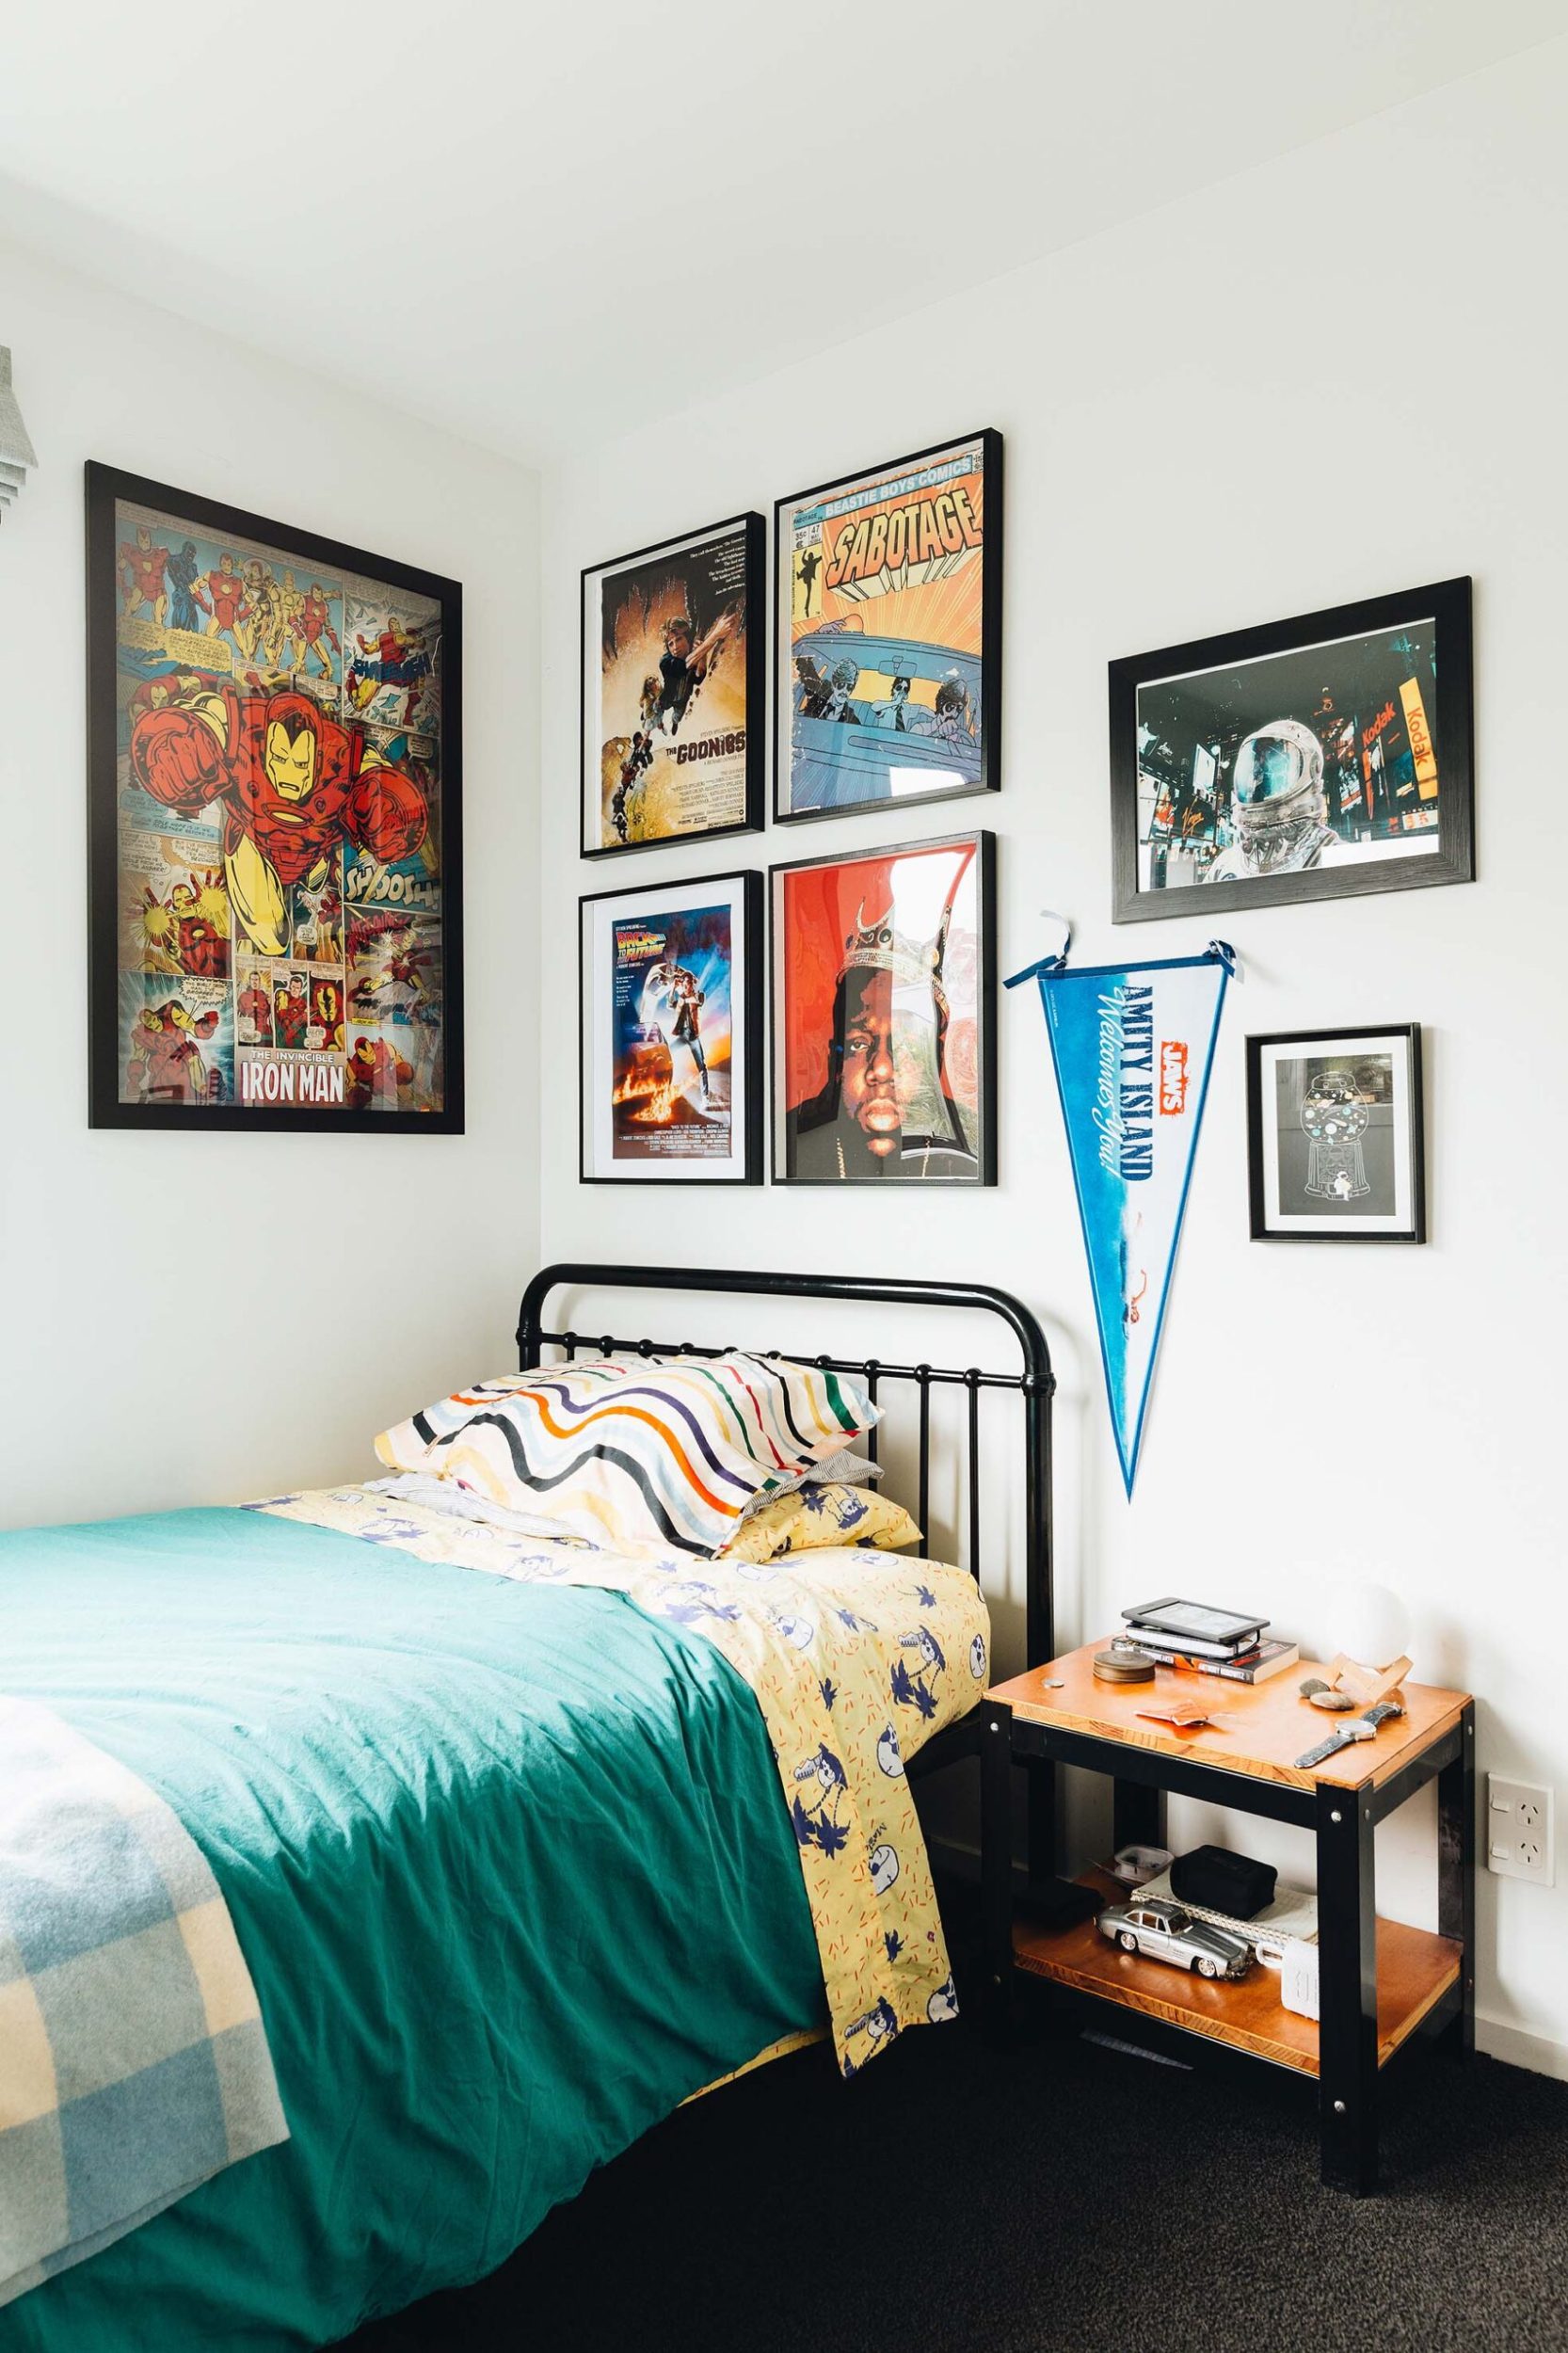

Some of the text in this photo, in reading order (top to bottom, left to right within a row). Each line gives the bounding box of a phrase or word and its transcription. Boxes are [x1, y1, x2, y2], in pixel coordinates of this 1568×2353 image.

[825, 490, 877, 517] BEASTIE
[881, 479, 915, 499] BOYS
[919, 457, 970, 486] COMICS
[811, 524, 820, 534] 47
[825, 488, 983, 590] SABOTAGE
[1362, 701, 1397, 747] Kodak
[1407, 707, 1431, 767] Kodak
[666, 746, 677, 757] THE
[616, 931, 662, 950] BACK
[618, 949, 626, 958] TO
[626, 943, 665, 962] FUTURE
[251, 1050, 334, 1063] THE INVINCIBLE
[1162, 1045, 1183, 1111] JAWS
[242, 1062, 344, 1103] IRON MAN
[1092, 986, 1127, 1178] Welcomes You!
[1120, 985, 1153, 1180] AMITY ISLAND
